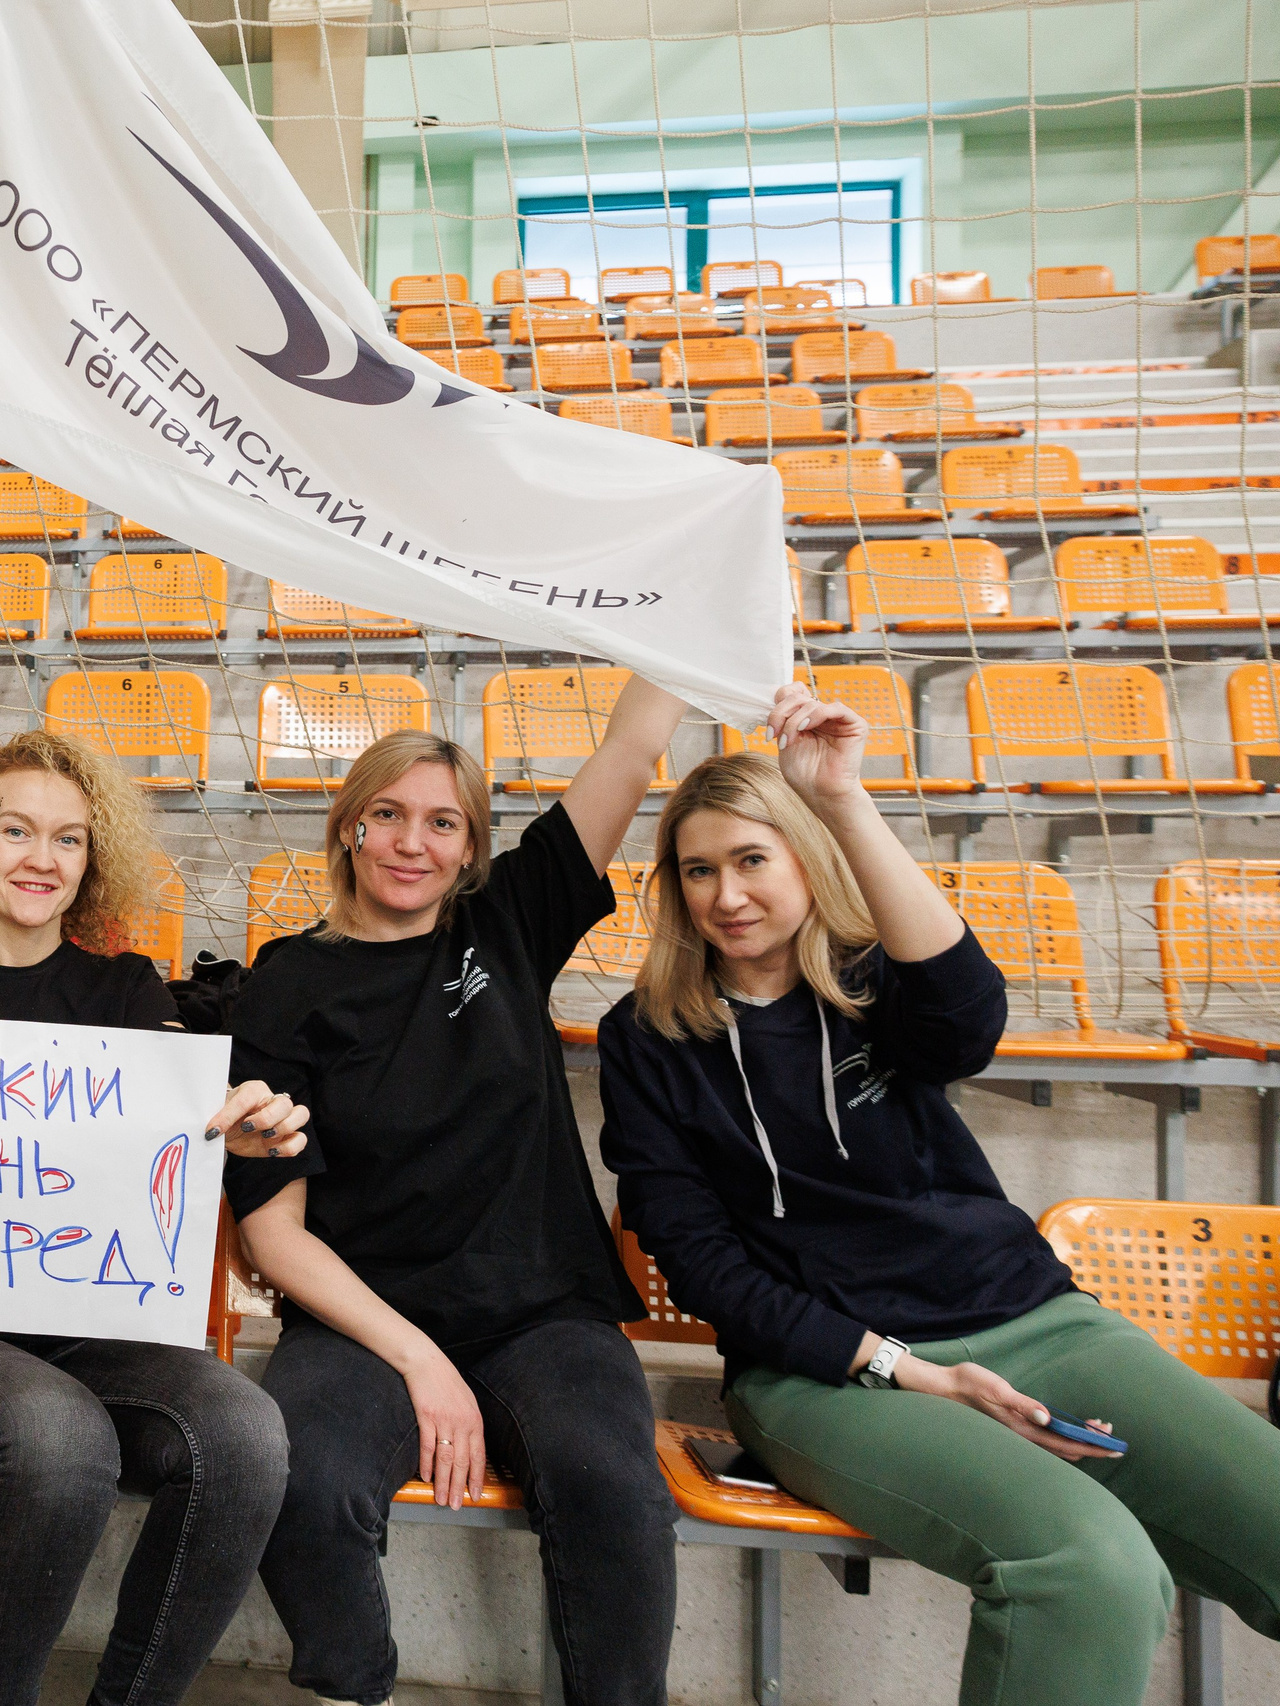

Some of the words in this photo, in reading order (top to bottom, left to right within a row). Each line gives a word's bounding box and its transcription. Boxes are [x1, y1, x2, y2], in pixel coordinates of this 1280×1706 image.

[64, 319, 216, 467] Тёплая
[91, 298, 366, 537] «ПЕРМСКИЙ
[830, 454, 838, 463] 2
[27, 476, 33, 484] 7
[922, 547, 931, 557] 2
[1131, 543, 1140, 553] 1
[154, 559, 163, 569] 6
[564, 677, 574, 688] 4
[1058, 671, 1069, 684] 2
[122, 679, 132, 690] 6
[339, 681, 349, 693] 5
[943, 872, 956, 888] 3
[1192, 1217, 1212, 1242] 3
